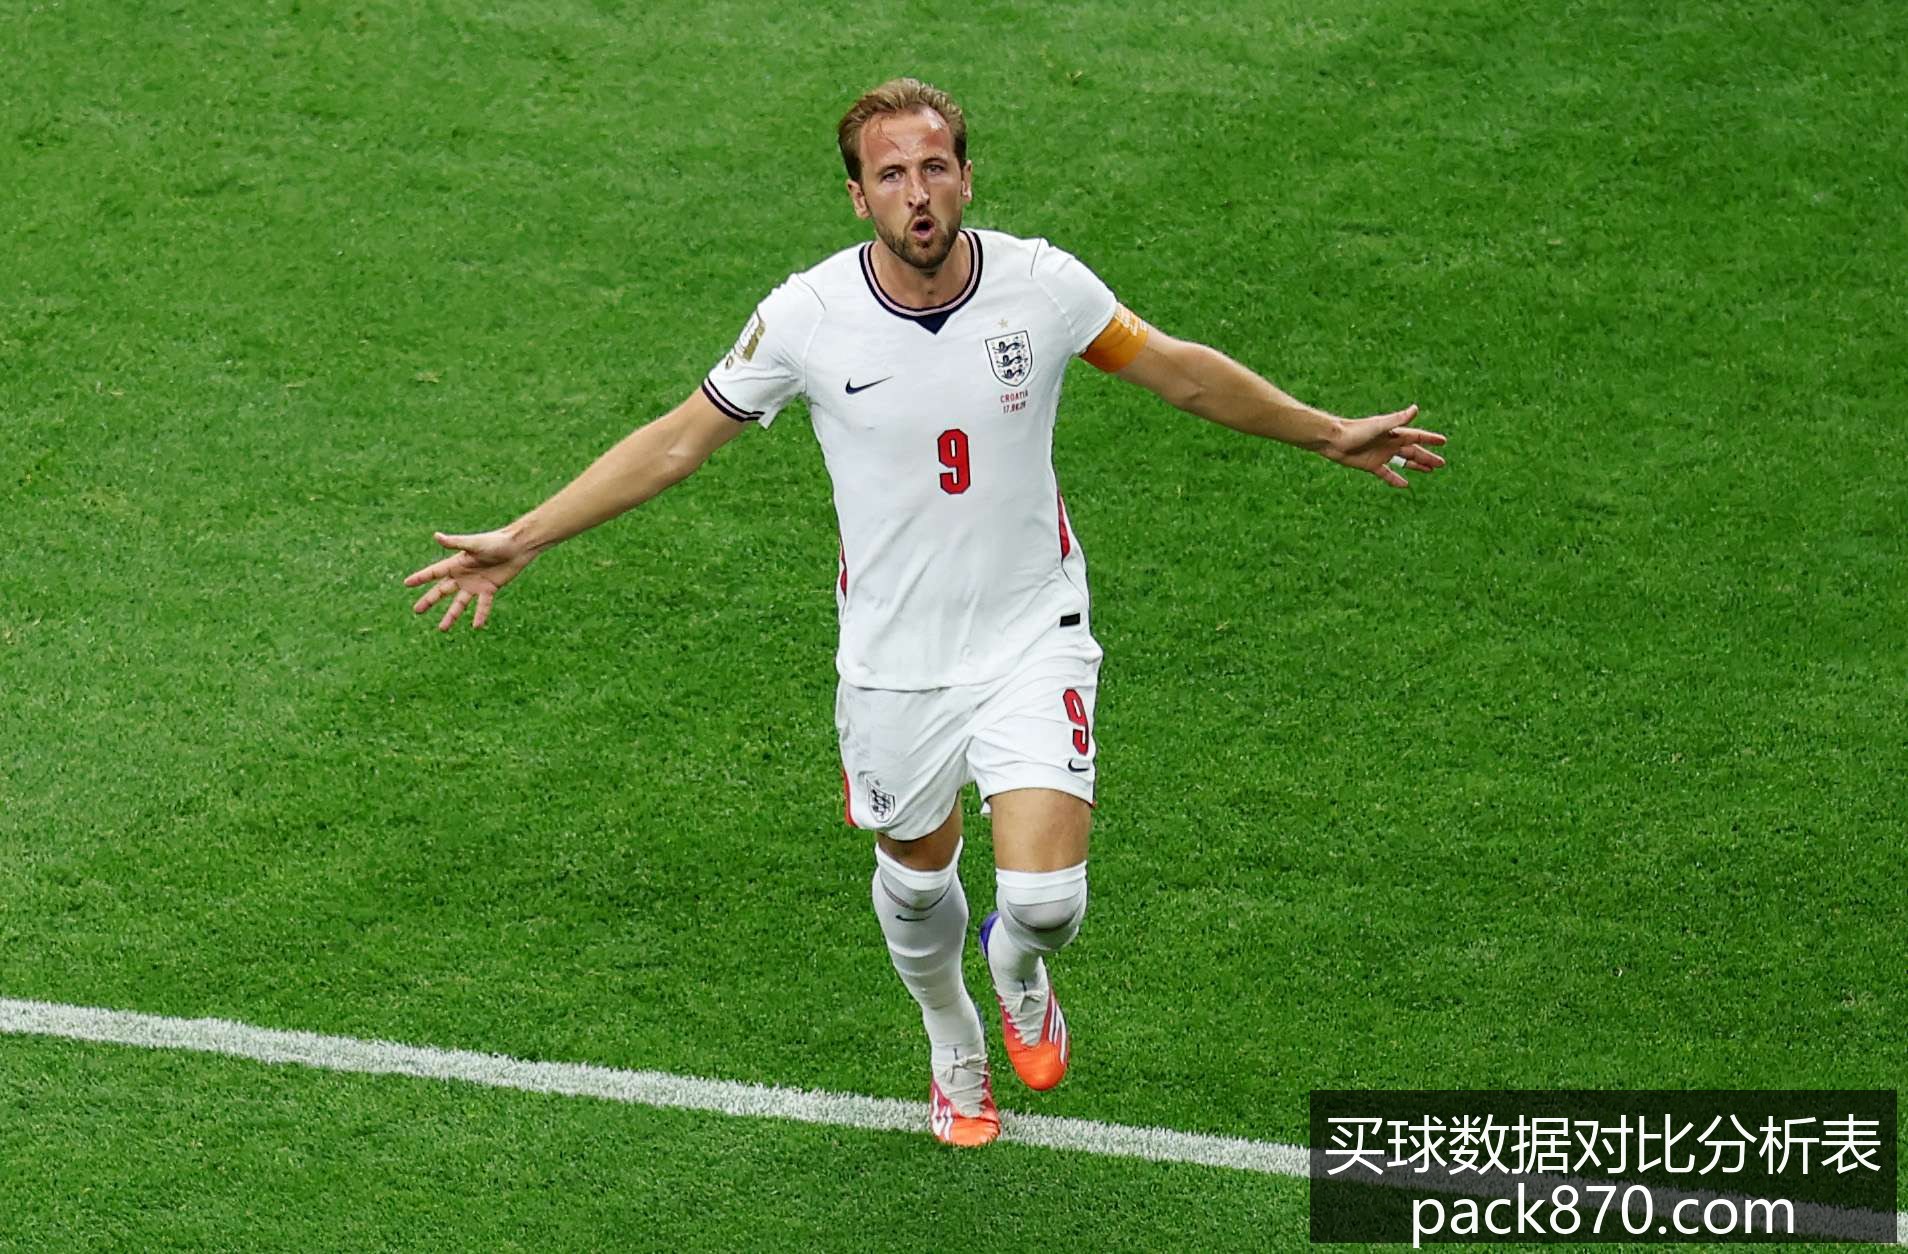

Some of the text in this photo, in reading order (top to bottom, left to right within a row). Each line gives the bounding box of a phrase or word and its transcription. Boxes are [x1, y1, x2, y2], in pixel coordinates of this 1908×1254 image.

[1000, 389, 1029, 403] CROATIA
[936, 428, 971, 495] 9
[1062, 687, 1090, 757] 9
